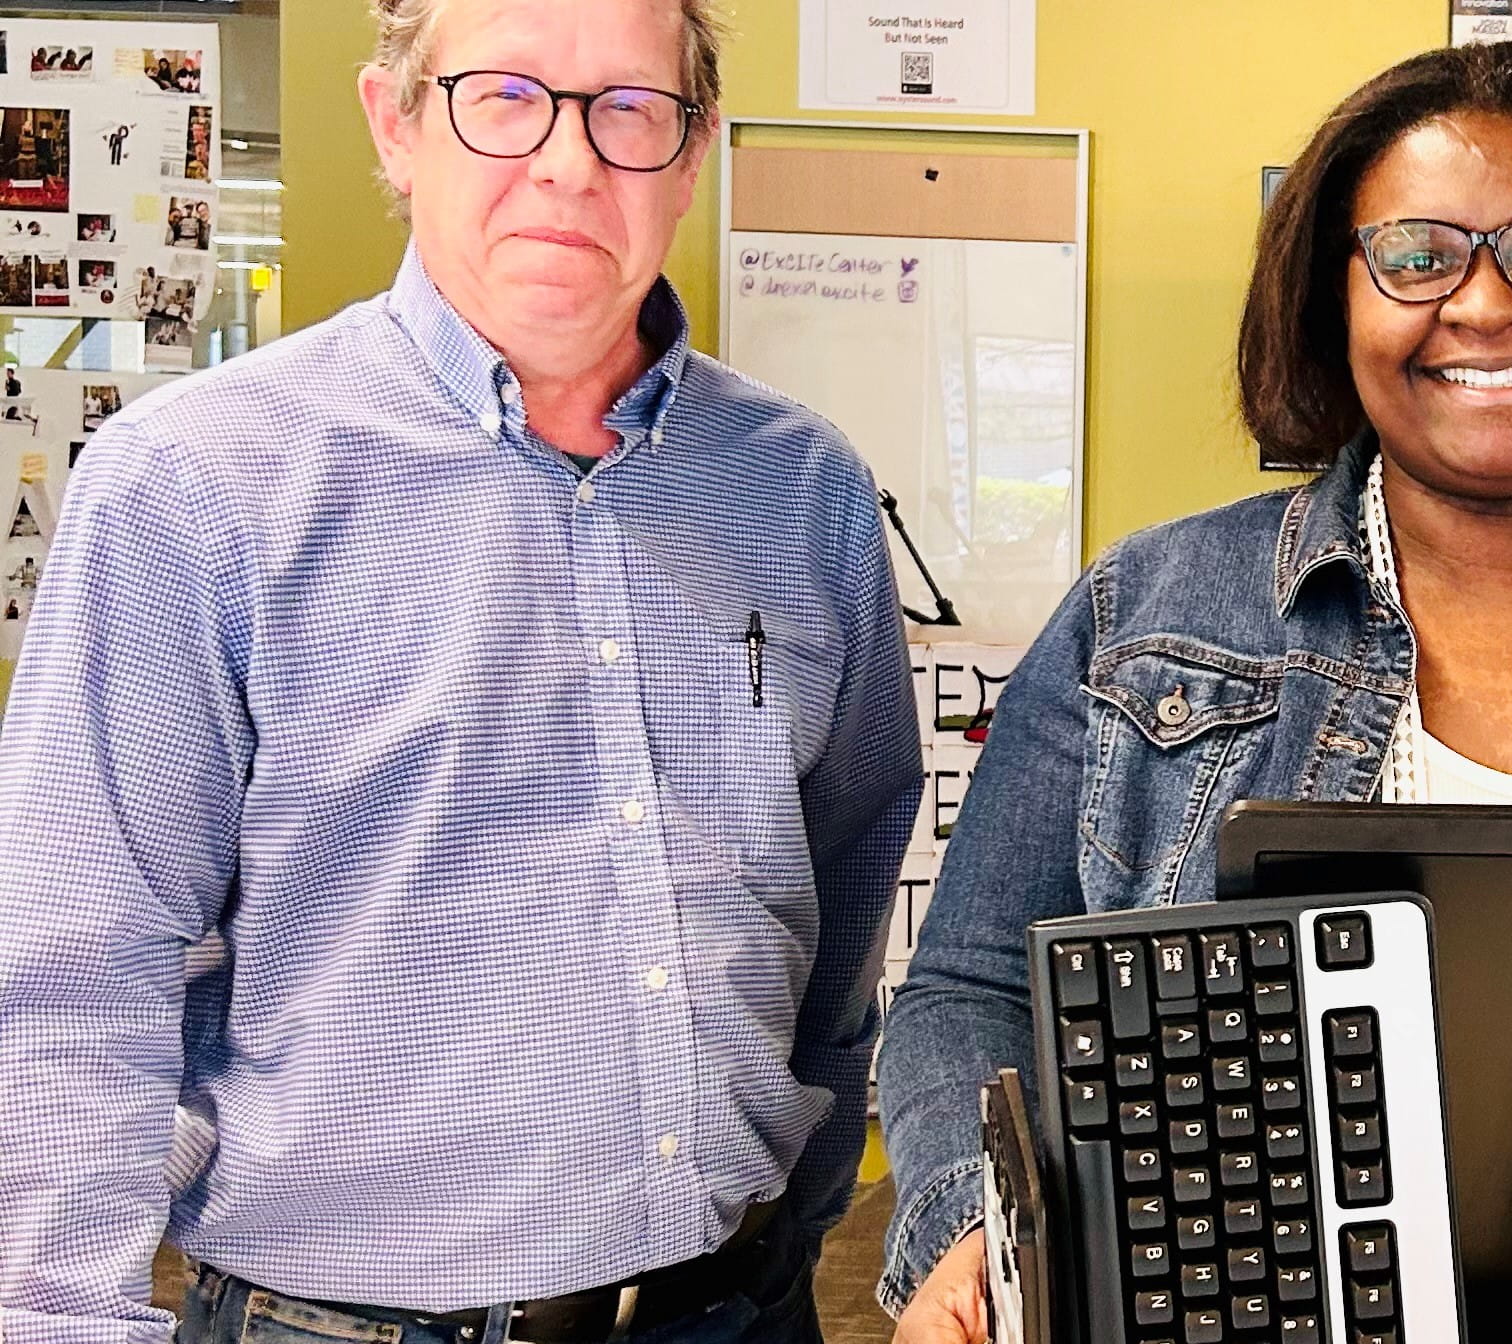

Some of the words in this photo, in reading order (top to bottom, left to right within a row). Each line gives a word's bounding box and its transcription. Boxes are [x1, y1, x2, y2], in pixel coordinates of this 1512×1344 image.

[868, 16, 899, 27] Sound
[901, 16, 922, 28] That
[935, 18, 964, 29] Heard
[885, 33, 901, 43] But
[904, 33, 922, 44] Not
[924, 34, 948, 44] Seen
[1225, 1013, 1240, 1026] Q
[1178, 1030, 1193, 1041] A
[1348, 1027, 1357, 1038] F1
[1262, 1035, 1274, 1043] 2
[1131, 1058, 1147, 1070] Z
[1229, 1061, 1244, 1077] W
[1182, 1077, 1197, 1088] S
[1265, 1083, 1278, 1091] 3
[1135, 1106, 1151, 1118] X
[1232, 1108, 1247, 1119] E
[1186, 1124, 1201, 1136] D
[1270, 1131, 1281, 1139] 4
[1140, 1153, 1155, 1165] C
[1236, 1157, 1251, 1168] R
[1189, 1173, 1204, 1183] F
[1272, 1179, 1285, 1187] 5
[1143, 1201, 1158, 1212] V
[1240, 1205, 1254, 1215] T
[1194, 1220, 1209, 1233] G
[1277, 1226, 1289, 1235] 6
[1146, 1247, 1162, 1259] B
[1365, 1242, 1374, 1254] F5
[1243, 1252, 1258, 1263] Y
[1196, 1267, 1211, 1279] H
[1281, 1272, 1293, 1281] 7
[1151, 1296, 1166, 1308] N
[1247, 1299, 1262, 1311] U
[1200, 1316, 1215, 1324] J
[1284, 1321, 1296, 1329] 8
